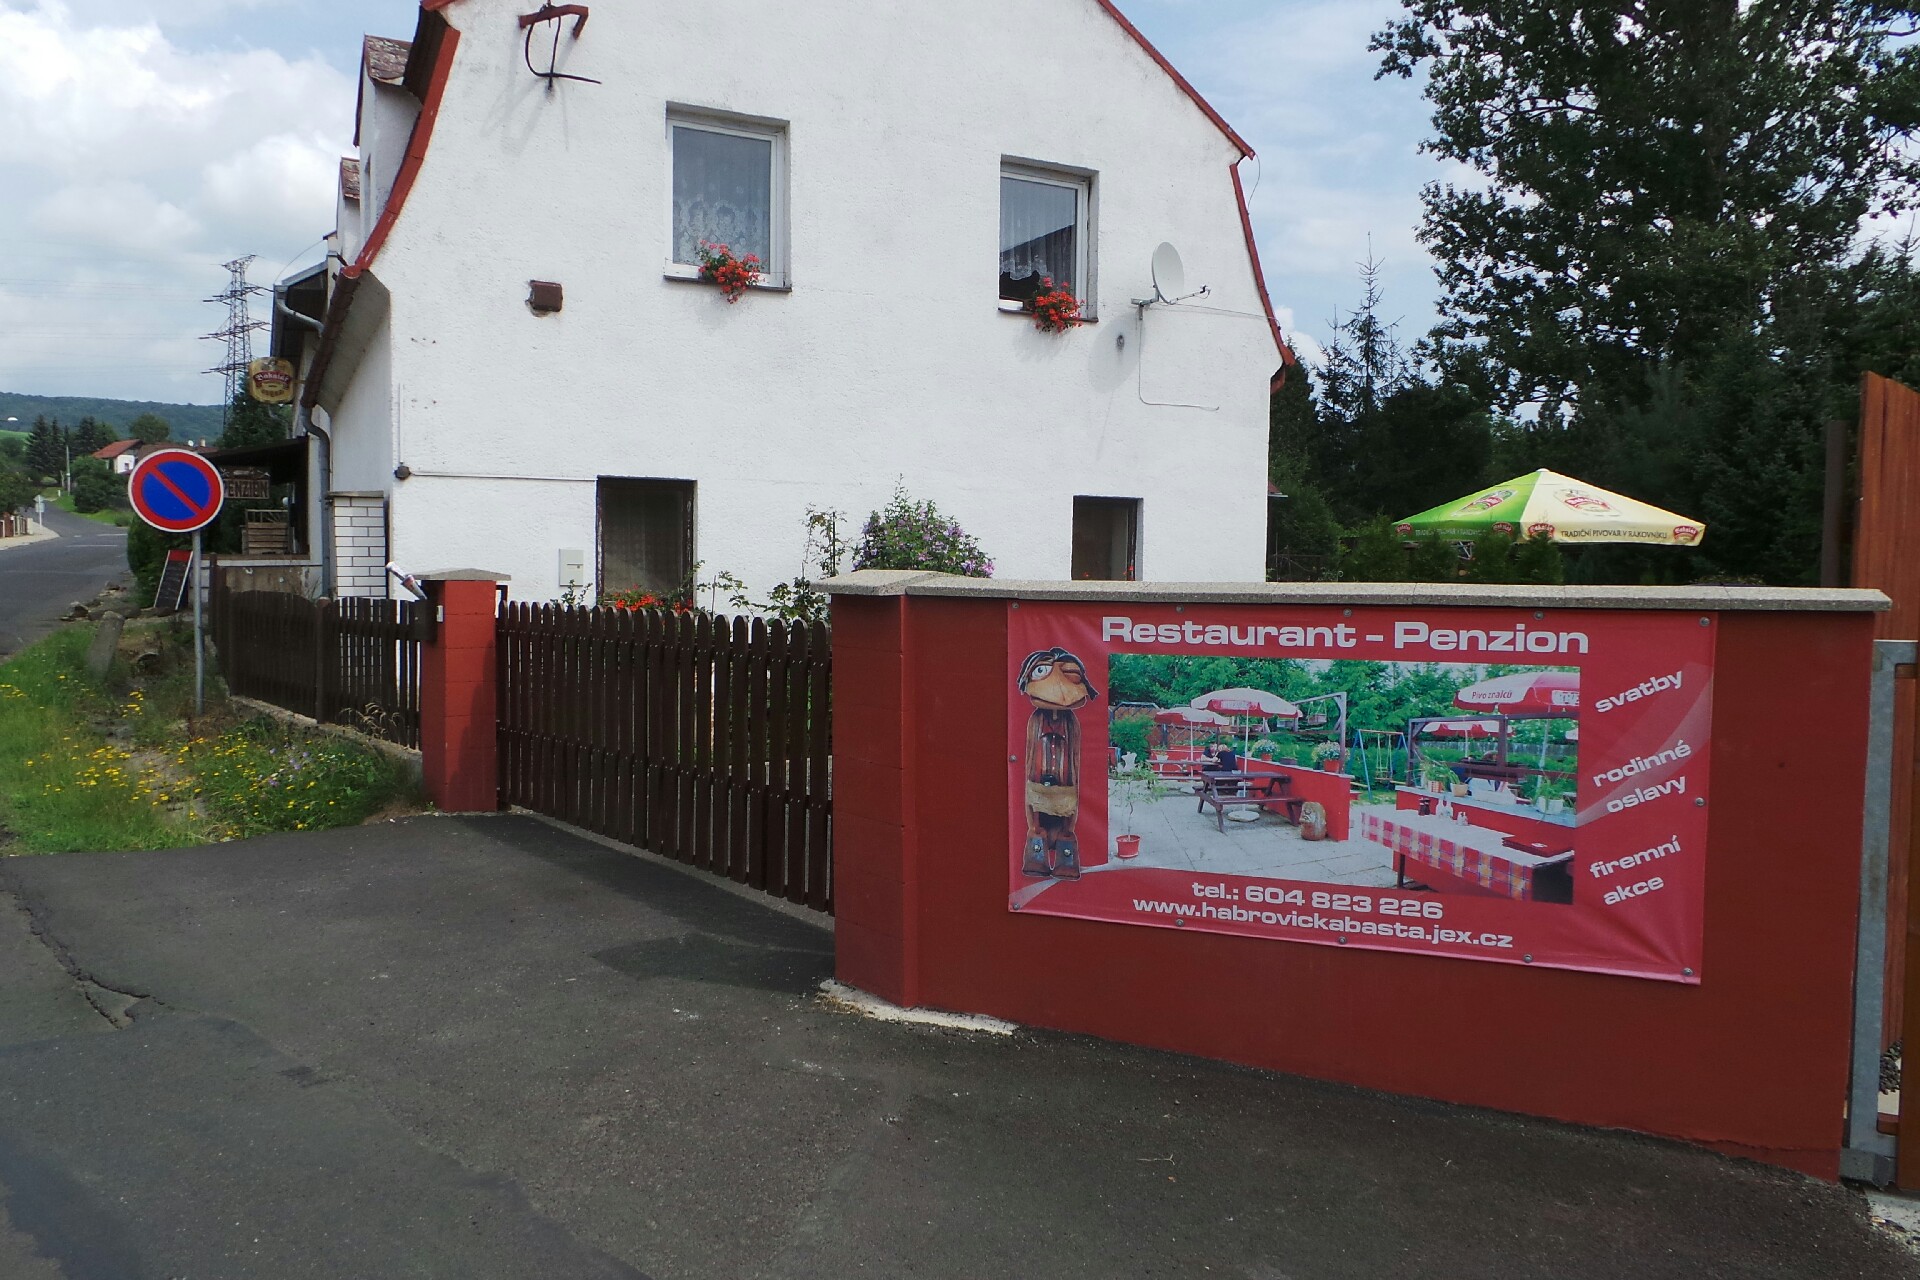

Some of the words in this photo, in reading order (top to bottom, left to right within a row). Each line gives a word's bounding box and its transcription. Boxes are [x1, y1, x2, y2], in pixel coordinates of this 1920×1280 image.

[1592, 530, 1621, 538] PIVOVAR
[1622, 530, 1628, 538] V
[1102, 616, 1357, 648] Restaurant
[1394, 621, 1590, 654] Penzion
[1471, 691, 1487, 700] Pivo
[1594, 670, 1683, 714] svatby
[1592, 739, 1692, 788] rodinné
[1606, 776, 1686, 814] oslavy
[1589, 834, 1682, 879] firemní
[1191, 881, 1239, 901] tel.:
[1244, 885, 1306, 907] 604
[1310, 892, 1373, 914] 823
[1378, 898, 1444, 920] 226
[1602, 876, 1665, 906] akce
[1132, 898, 1514, 948] www.habrovickabasta.jex.cz
